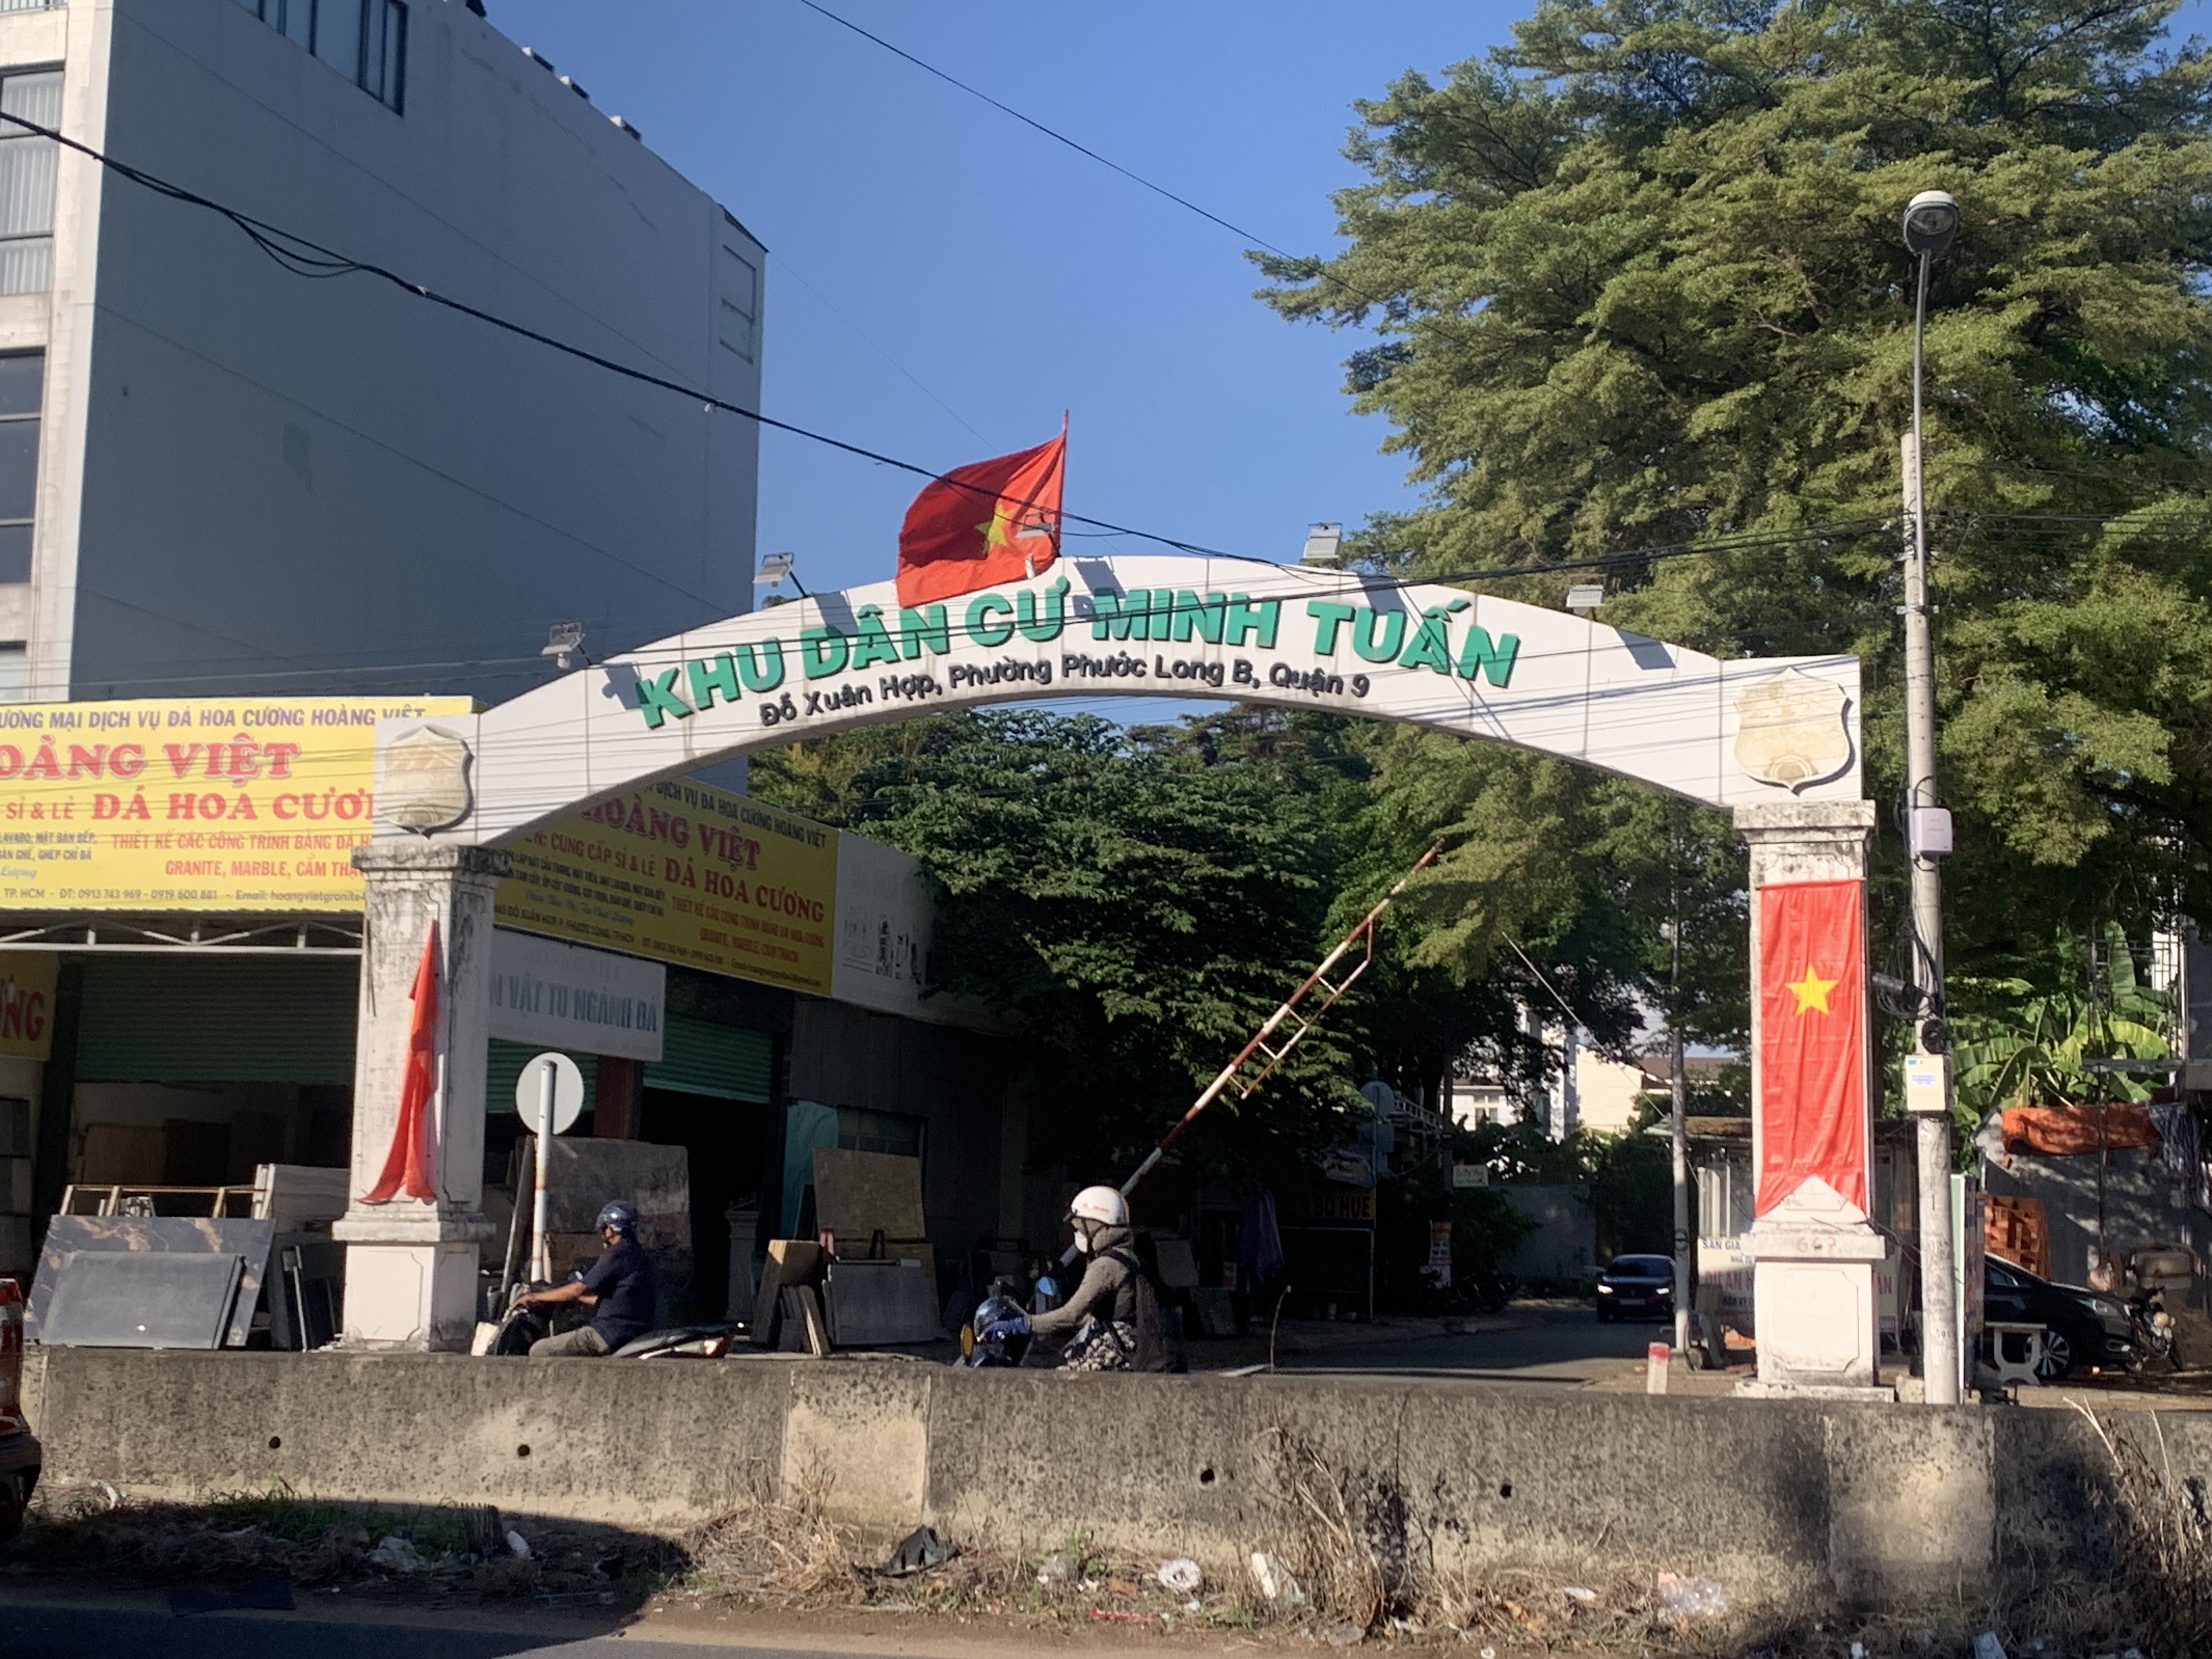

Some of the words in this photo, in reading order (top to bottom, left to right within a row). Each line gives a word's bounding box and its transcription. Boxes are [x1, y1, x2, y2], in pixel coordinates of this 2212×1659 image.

[636, 636, 785, 729] KHU
[800, 603, 951, 680] DÂN
[965, 575, 1071, 647] CƯ
[1091, 587, 1282, 649] MINH
[1307, 599, 1521, 688] TUẤN
[805, 683, 872, 716] Xuân
[880, 676, 943, 701] Hợp,
[950, 654, 1052, 689] Phường
[1062, 651, 1147, 679] Phước
[1154, 654, 1224, 687] Long
[1233, 658, 1260, 689] B,
[1269, 661, 1344, 698] Quận
[1352, 676, 1370, 698] 9
[49, 712, 82, 731] MẠI
[88, 711, 131, 731] DỊCH
[138, 712, 160, 731] VỤ
[167, 706, 191, 727] ĐÁ
[200, 709, 236, 726] HOA
[242, 706, 304, 726] CƯƠNG
[311, 704, 375, 726] HOÀNG
[162, 731, 301, 786] VIỆT
[30, 803, 44, 820] &
[91, 785, 152, 820] ĐÁ
[166, 793, 258, 820] HOA
[272, 786, 373, 821] CƯƠ
[166, 860, 226, 877] GRANITE,
[231, 860, 291, 879] MARBLE,
[697, 825, 761, 871] VIỆT
[20, 888, 44, 899] HCM
[551, 832, 584, 857] CUNG
[630, 855, 638, 871] &
[664, 857, 696, 888] ĐÁ
[704, 868, 749, 904] HOA
[755, 884, 825, 923] CƯƠNG
